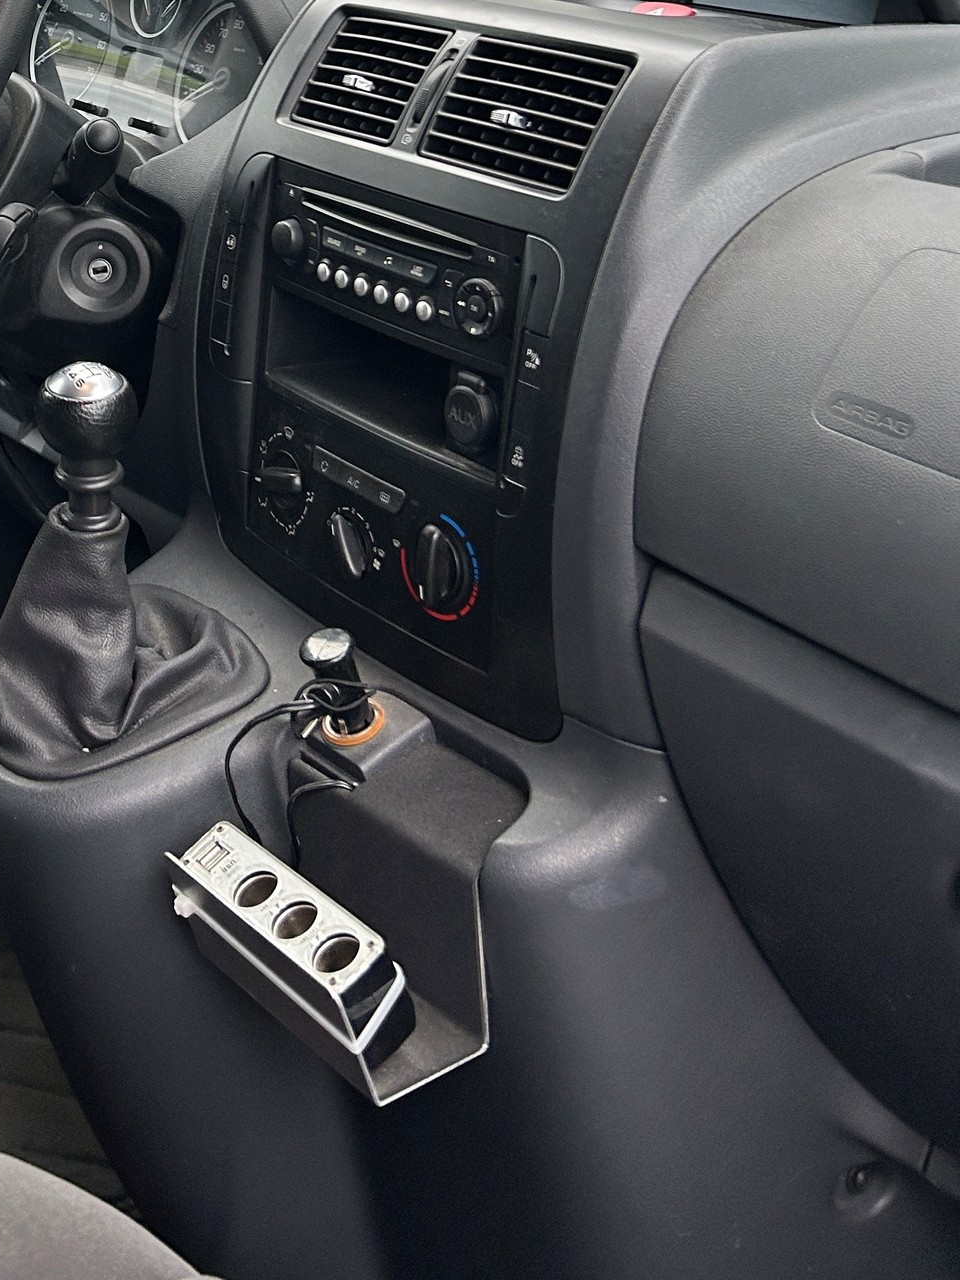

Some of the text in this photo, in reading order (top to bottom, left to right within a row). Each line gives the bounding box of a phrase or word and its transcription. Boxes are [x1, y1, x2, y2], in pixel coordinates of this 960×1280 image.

[59, 3, 69, 12] 20
[98, 12, 108, 22] 50
[218, 28, 228, 38] 70
[204, 43, 215, 54] 50
[193, 63, 204, 74] 30
[448, 406, 477, 430] AUX
[831, 399, 910, 437] AIRBAG
[511, 458, 524, 469] OFF
